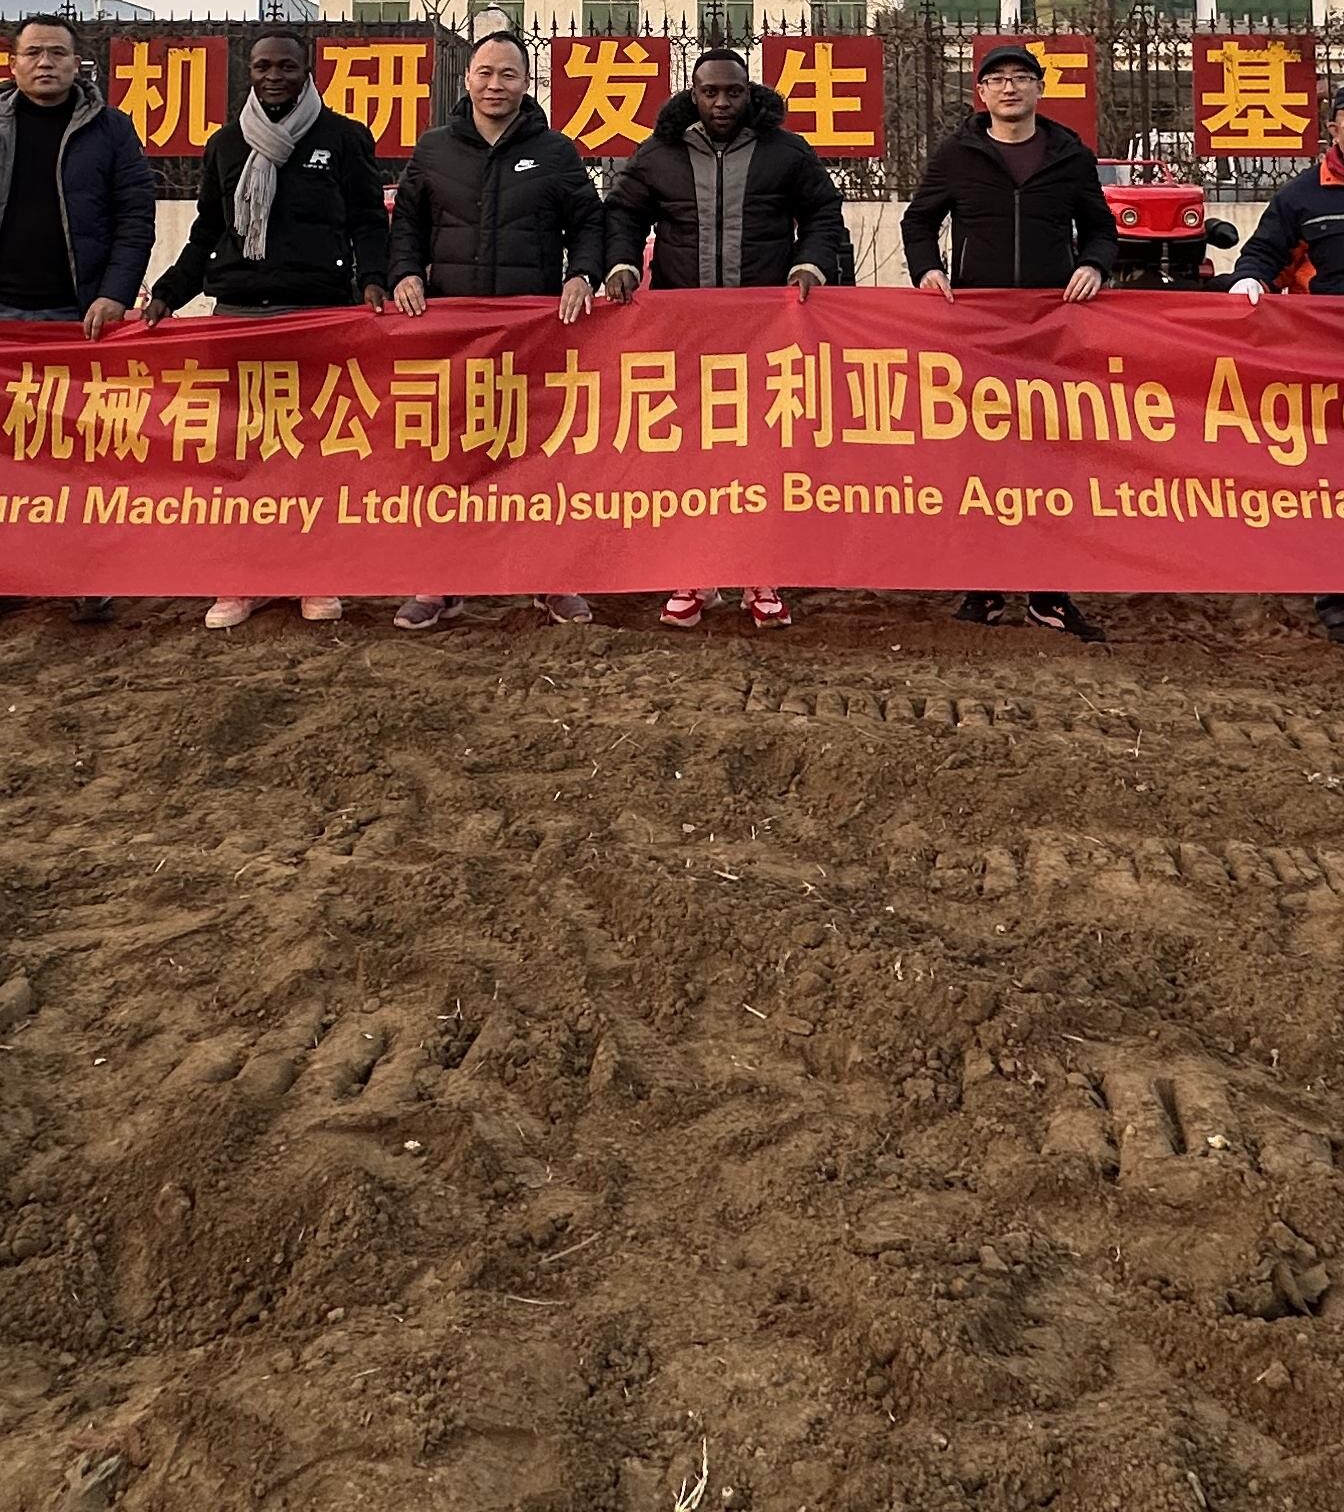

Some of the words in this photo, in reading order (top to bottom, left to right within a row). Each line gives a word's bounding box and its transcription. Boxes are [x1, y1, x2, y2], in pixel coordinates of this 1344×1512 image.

[84, 486, 323, 532] Machinery
[338, 481, 768, 529] Ltd(China)supports
[783, 472, 943, 516] Bennie
[959, 476, 1074, 526] Agro
